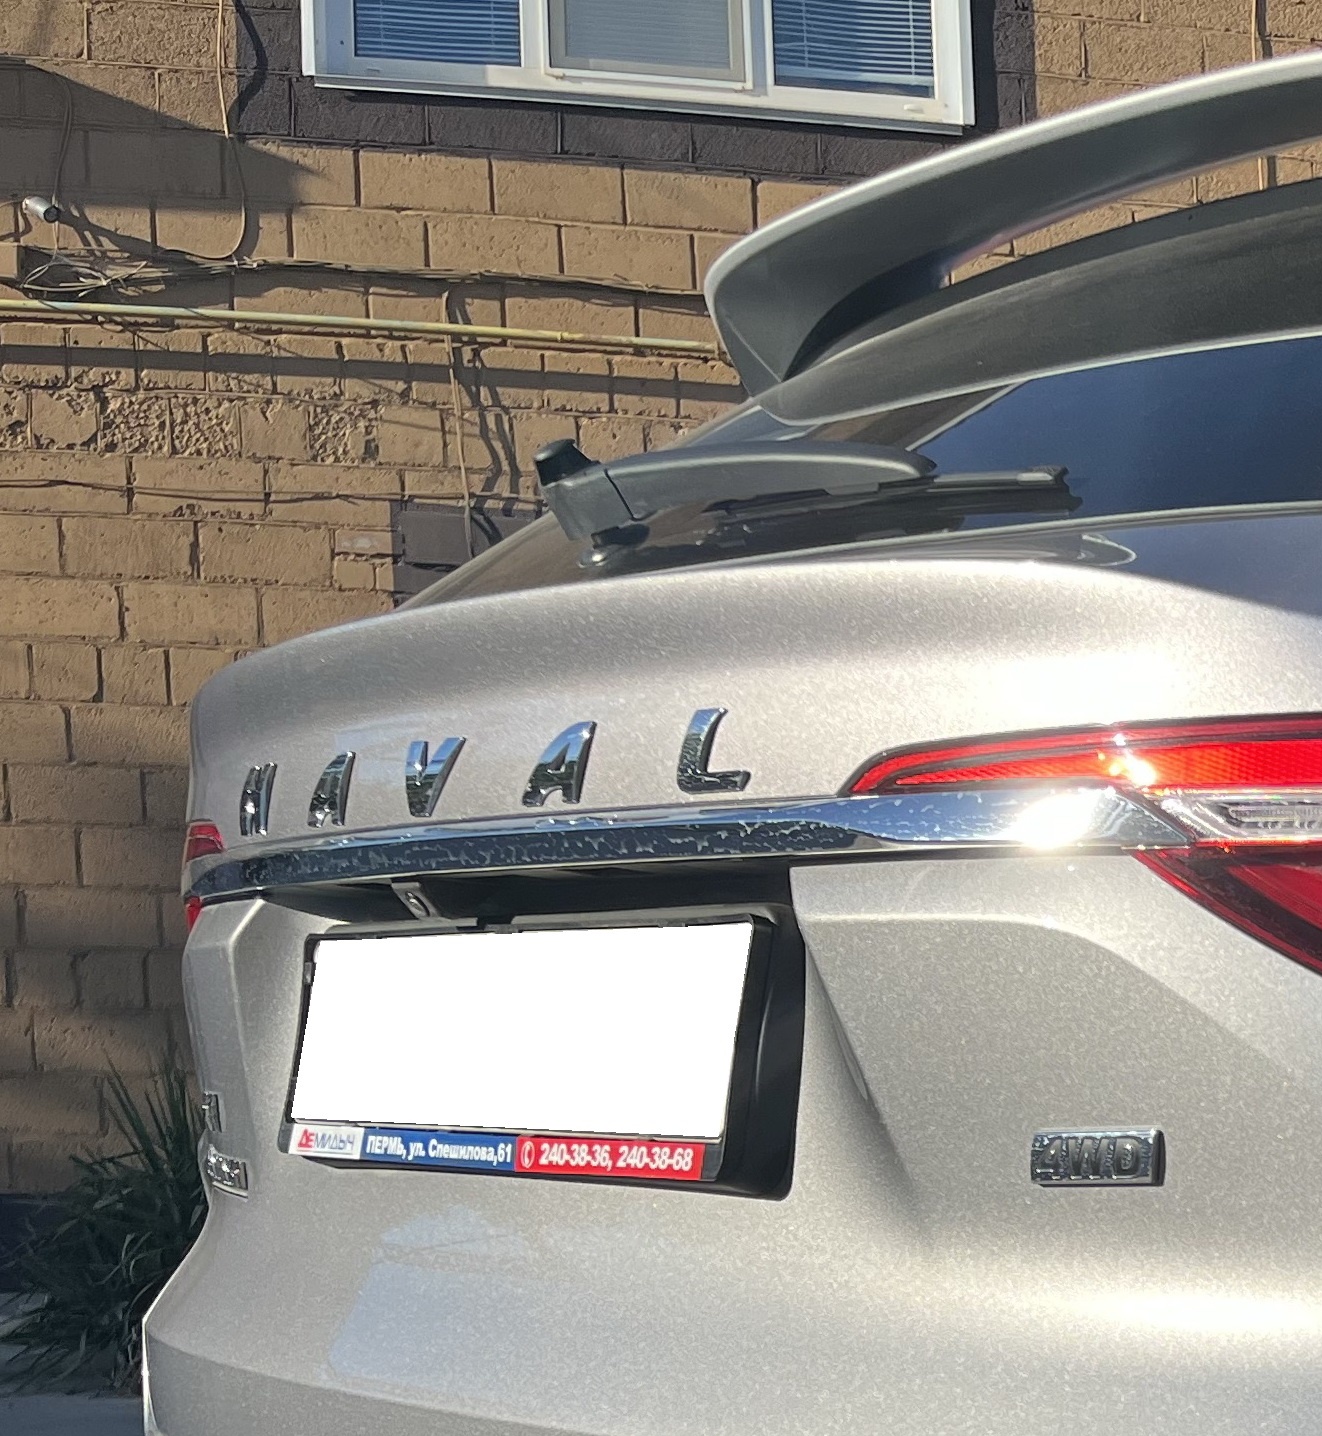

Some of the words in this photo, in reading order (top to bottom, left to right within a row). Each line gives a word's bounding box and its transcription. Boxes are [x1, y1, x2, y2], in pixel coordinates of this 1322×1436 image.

[240, 707, 752, 837] HAVAL
[365, 1135, 406, 1159] ПЕРМЬ,
[408, 1141, 426, 1160] ул.
[539, 1142, 613, 1172] 240-38-36,
[615, 1145, 694, 1172] 240-38-68
[1034, 1136, 1143, 1180] 4WD
